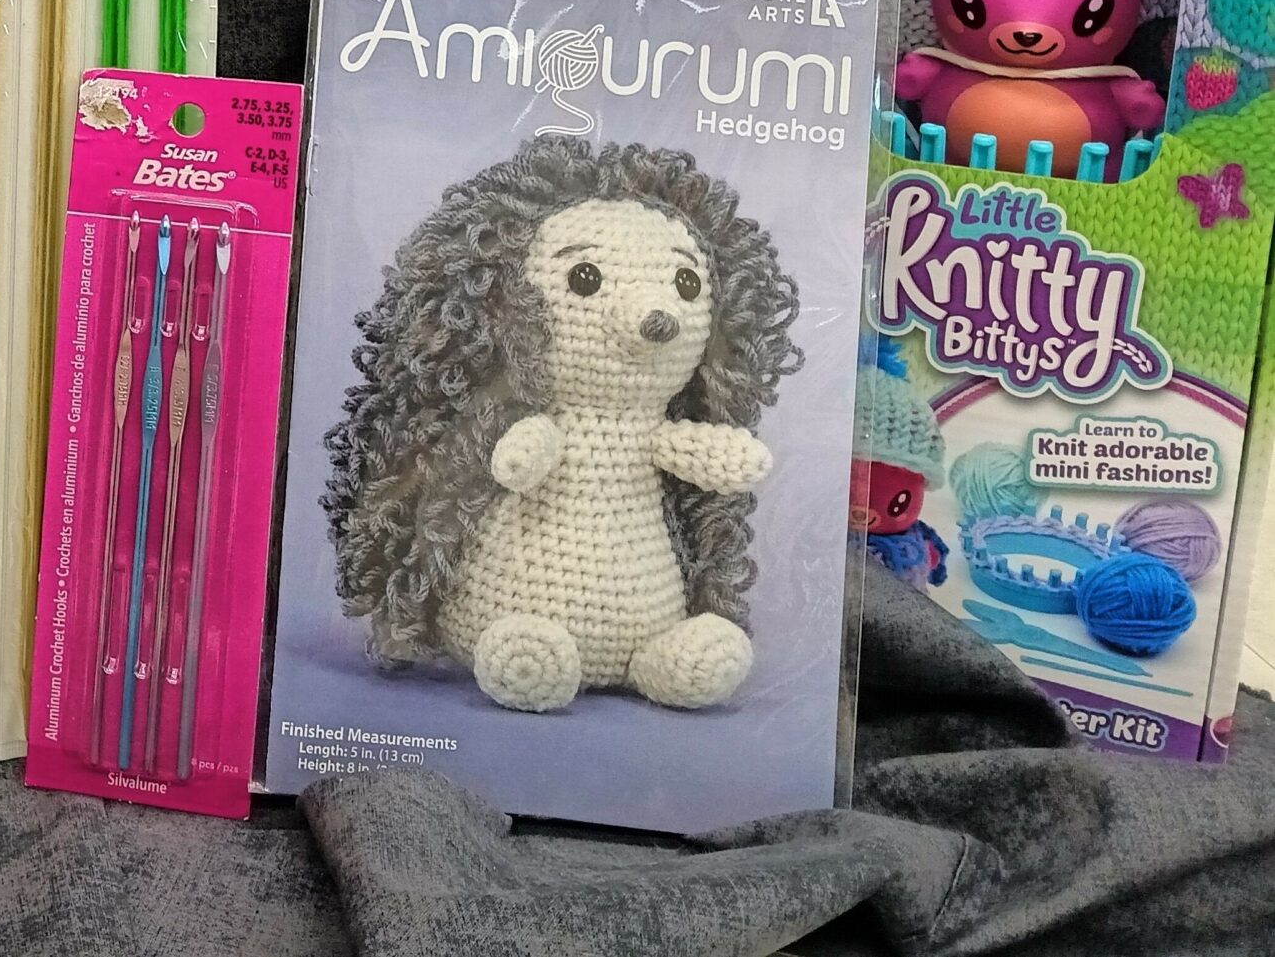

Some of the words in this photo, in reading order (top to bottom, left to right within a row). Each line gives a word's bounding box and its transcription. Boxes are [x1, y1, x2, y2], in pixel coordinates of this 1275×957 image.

[748, 5, 805, 25] ARTS
[231, 98, 261, 113] 2.75,
[264, 101, 294, 115] 3.25,
[236, 113, 265, 127] 3.50,
[267, 115, 292, 129] 3.75
[696, 109, 845, 150] Hedgehog
[271, 132, 292, 141] mm
[160, 143, 218, 163] Susan
[245, 146, 266, 161] C-2,
[268, 149, 290, 163] D-3,
[133, 158, 227, 192] Bates
[250, 161, 271, 177] E-4,
[272, 162, 289, 176] F-5
[273, 178, 288, 189] US
[959, 189, 1057, 234] Little
[82, 222, 96, 266] crochet
[80, 268, 94, 296] para
[883, 185, 1125, 388] Knitty
[72, 297, 89, 352] aluminio
[944, 315, 1067, 381] Bittys
[70, 354, 86, 370] de
[67, 371, 84, 422] Ganchos
[1085, 422, 1134, 438] Learn
[1138, 425, 1157, 438] to
[1037, 436, 1088, 457] Knit
[1093, 440, 1208, 462] adorable
[61, 439, 79, 507] aluminium
[1035, 460, 1090, 480] mini
[1096, 463, 1212, 485] fashions!
[63, 508, 73, 524] en
[56, 525, 72, 577] Crochets
[53, 589, 68, 627] Hooks
[49, 628, 65, 674] Crochet
[45, 678, 62, 741] Aluminum
[281, 721, 344, 741] Finished
[348, 727, 458, 751] Measurements
[1113, 714, 1160, 745] Kit
[199, 760, 215, 770] pcs
[298, 757, 345, 774] Height:
[347, 762, 355, 773] 8
[299, 741, 348, 758] Length:
[351, 747, 358, 758] 5
[361, 747, 376, 760] in.
[379, 748, 398, 762] (13
[401, 751, 424, 766] cm)
[108, 773, 167, 794] Silvalume
